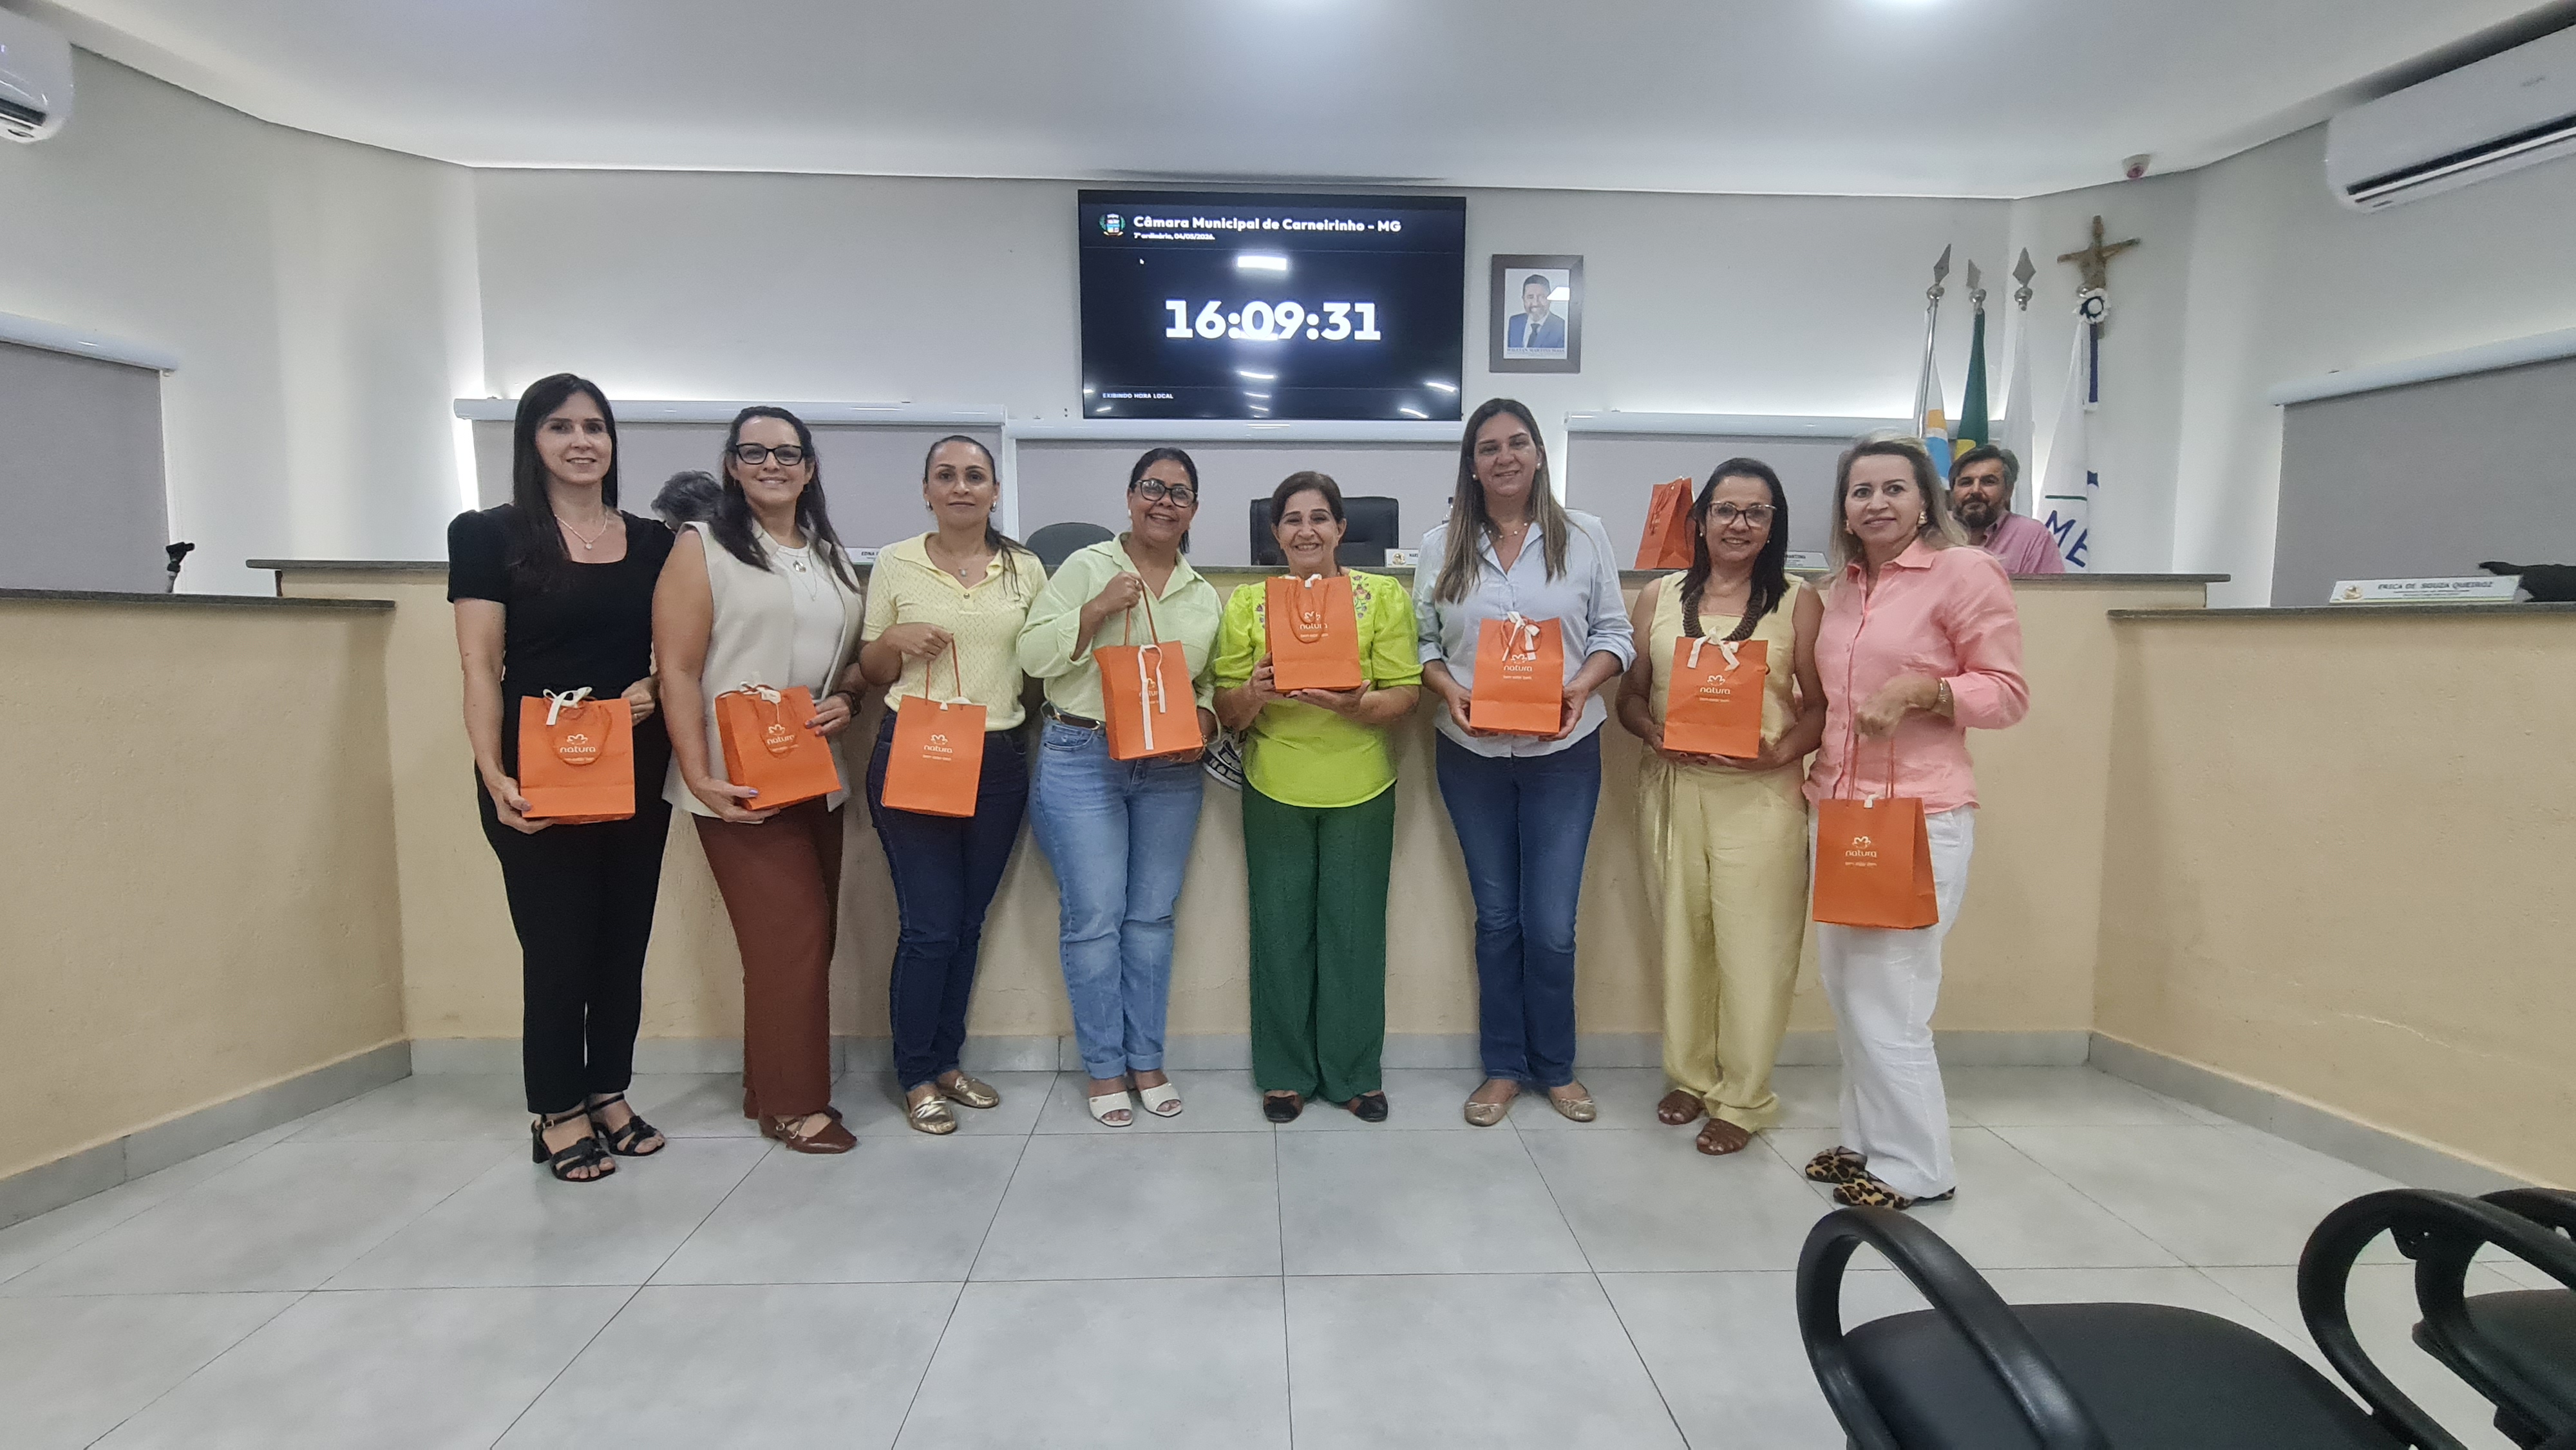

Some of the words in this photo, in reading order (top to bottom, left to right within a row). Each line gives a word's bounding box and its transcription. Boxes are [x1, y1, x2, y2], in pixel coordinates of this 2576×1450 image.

[1133, 216, 1189, 228] Câmara
[1192, 216, 1260, 231] Municipal
[1262, 218, 1280, 230] de
[1282, 218, 1365, 231] Carneirinho
[1377, 220, 1401, 232] MG
[1165, 299, 1381, 341] 16:09:31
[923, 744, 953, 753] natura
